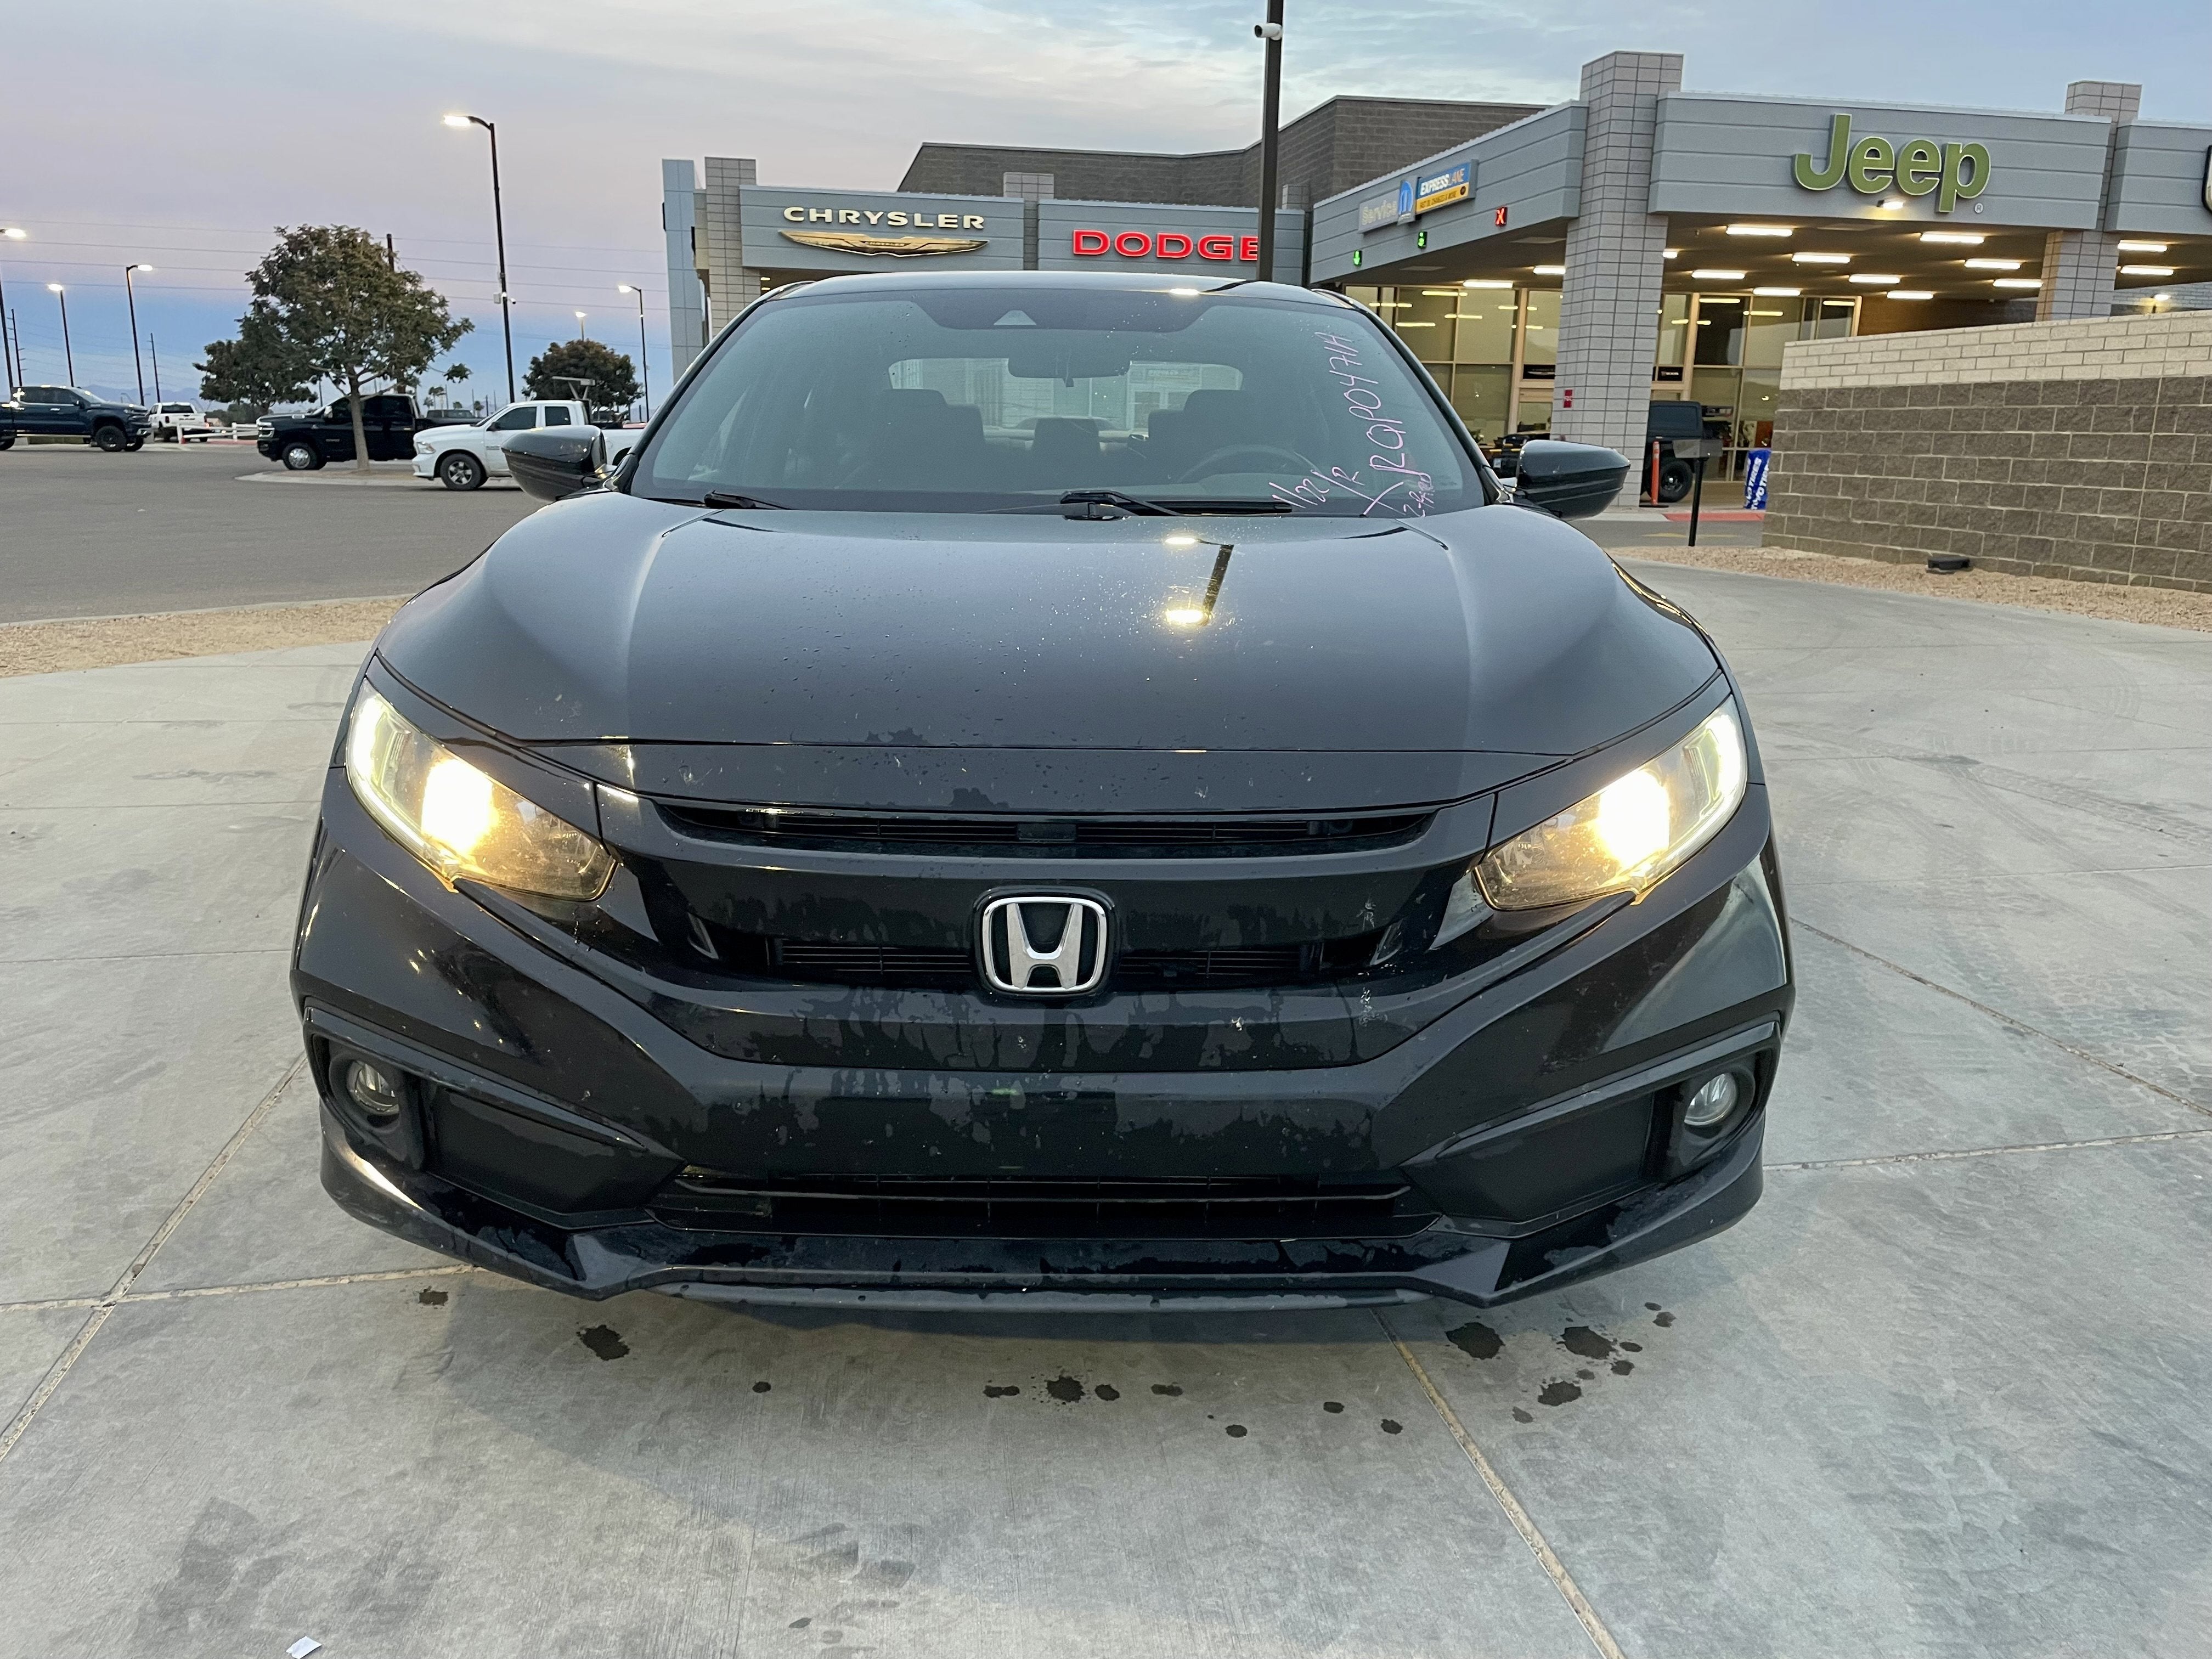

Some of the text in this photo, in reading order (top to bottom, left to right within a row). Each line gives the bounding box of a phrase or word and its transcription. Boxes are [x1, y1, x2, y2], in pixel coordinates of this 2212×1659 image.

[1794, 112, 1991, 213] Jeep
[1420, 173, 1450, 196] EXPRESS
[783, 207, 984, 229] CHRYSLER
[1362, 200, 1397, 225] Service
[1073, 229, 1259, 261] DODGE
